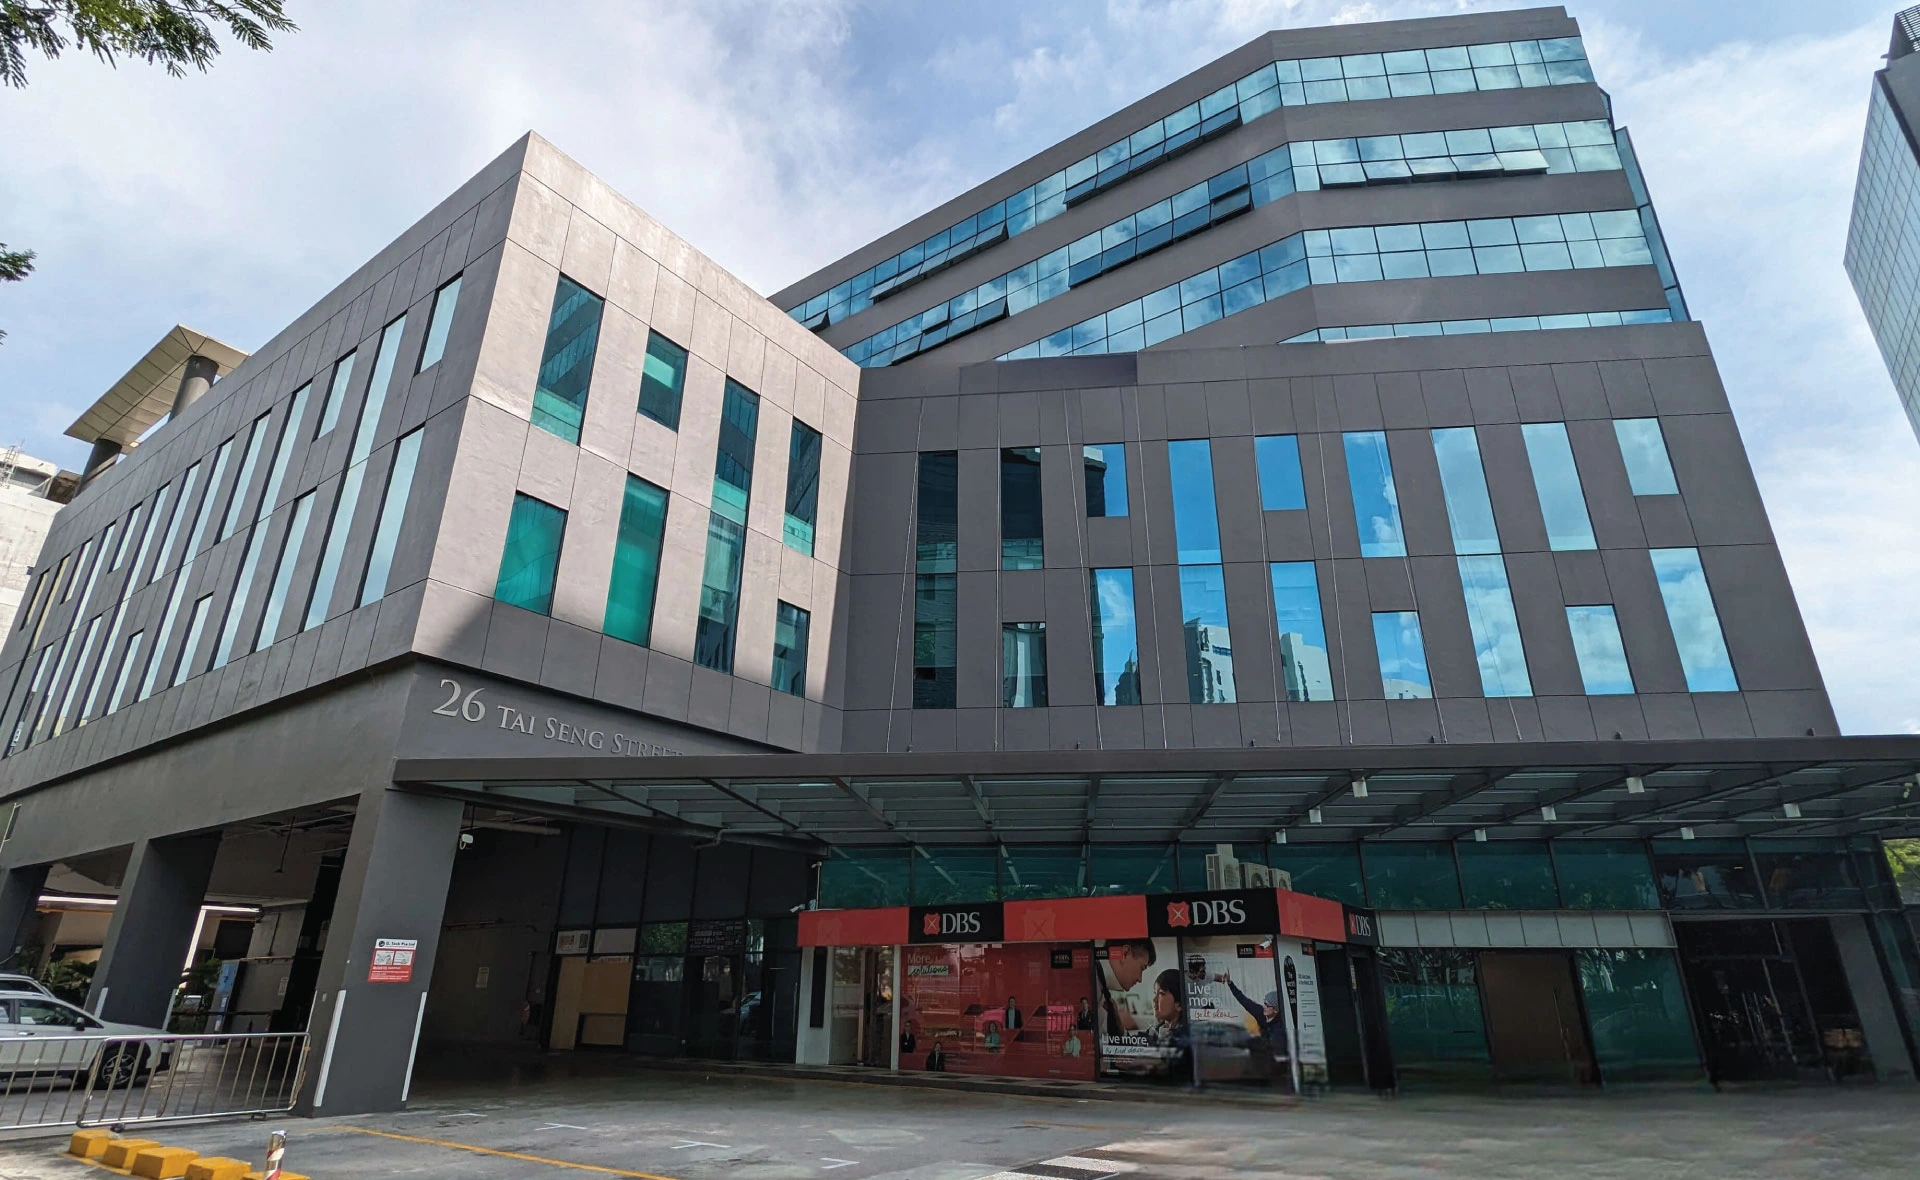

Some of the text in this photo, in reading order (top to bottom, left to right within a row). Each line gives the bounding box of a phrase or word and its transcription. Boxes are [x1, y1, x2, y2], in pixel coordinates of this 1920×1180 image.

[432, 679, 486, 722] 26
[497, 705, 536, 736] TAI
[942, 911, 981, 934] DBS
[1191, 899, 1246, 926] DBS
[1355, 916, 1371, 936] DBS
[1187, 982, 1211, 995] Live
[1101, 1033, 1149, 1047] Live more,
